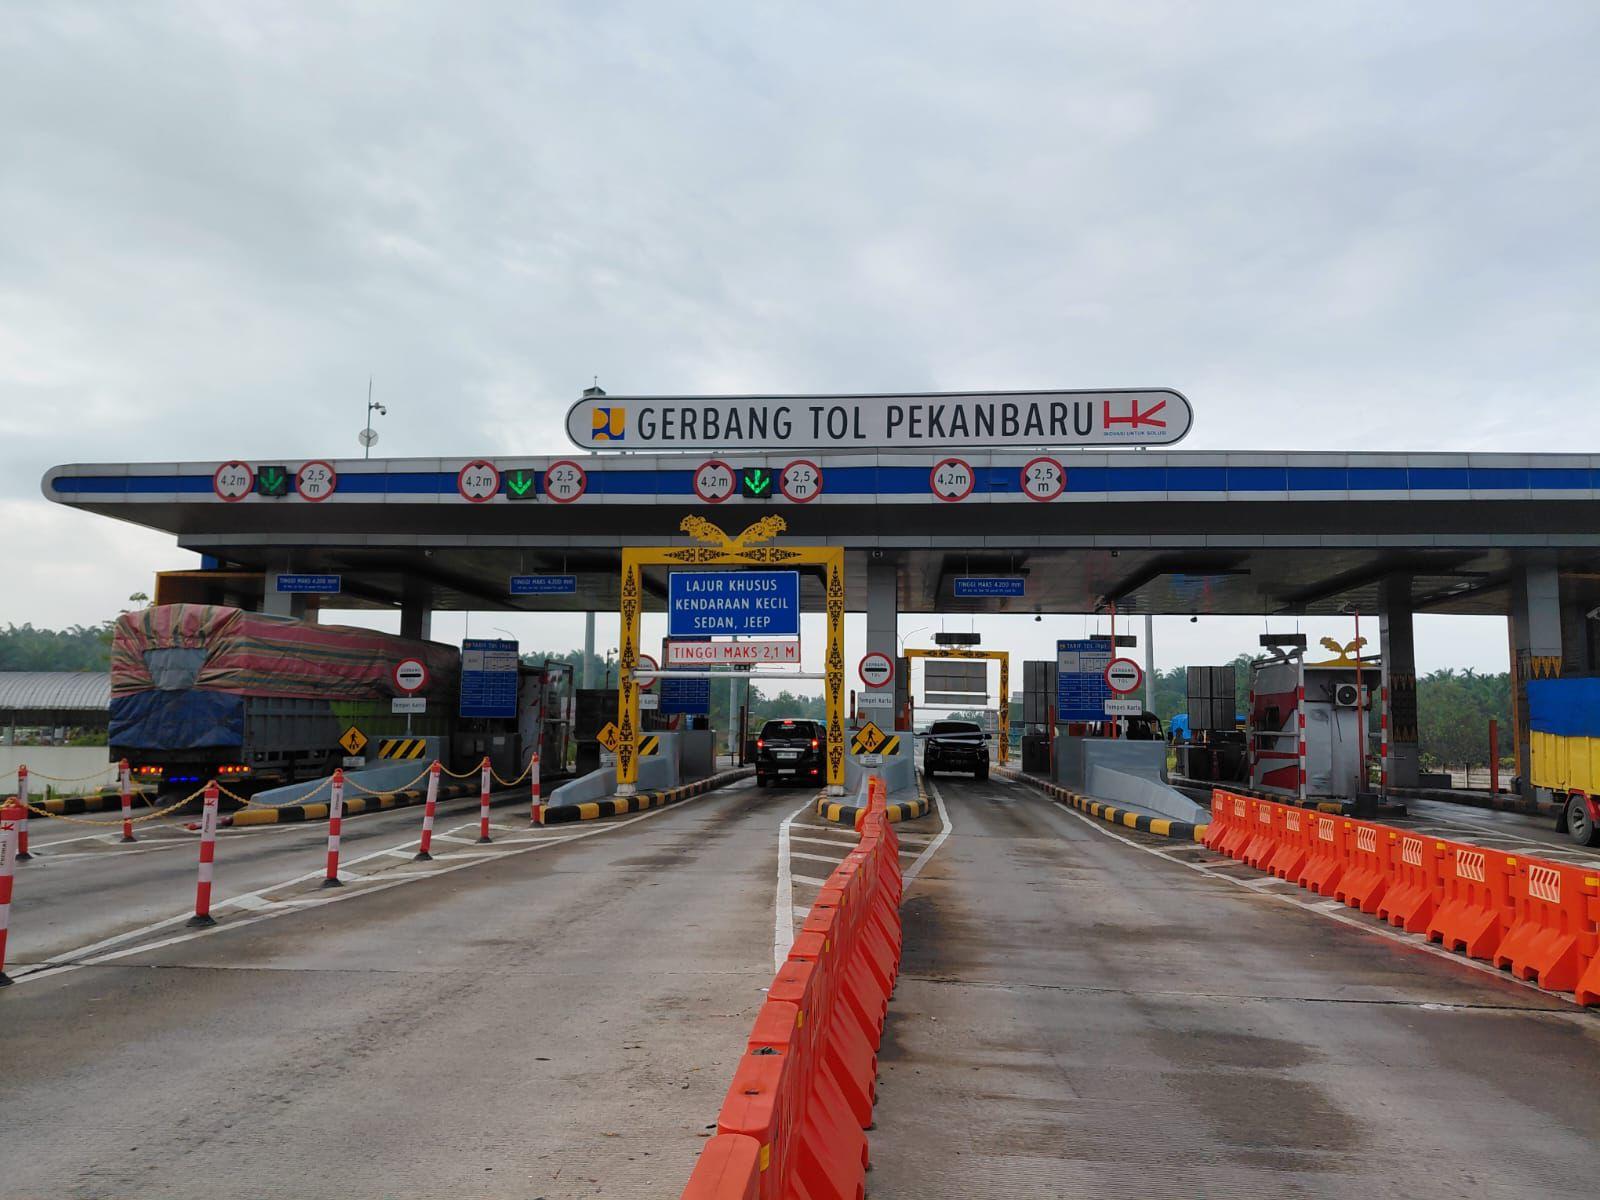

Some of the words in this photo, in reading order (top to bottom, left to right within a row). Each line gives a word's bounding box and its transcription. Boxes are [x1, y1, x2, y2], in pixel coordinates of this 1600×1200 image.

[637, 406, 792, 441] GERBANG
[809, 406, 866, 440] TOL
[886, 401, 1093, 438] PEKANBARU
[307, 470, 325, 482] 2,5
[556, 471, 574, 482] 2,5
[793, 471, 810, 482] 2,5
[1035, 468, 1053, 481] 2,5
[309, 484, 319, 492] m
[560, 484, 570, 493] m
[795, 484, 806, 494] m
[1038, 483, 1049, 492] m
[686, 580, 723, 592] LAJUR
[729, 579, 777, 591] KHUSUS
[675, 598, 749, 610] KENDARAAN
[756, 598, 788, 609] KECIL
[694, 616, 737, 629] SEDAN,
[743, 616, 771, 628] JEEP
[674, 647, 717, 658] TINGGI
[724, 647, 758, 658] MAKS
[763, 646, 779, 660] 2,1
[785, 646, 794, 658] M
